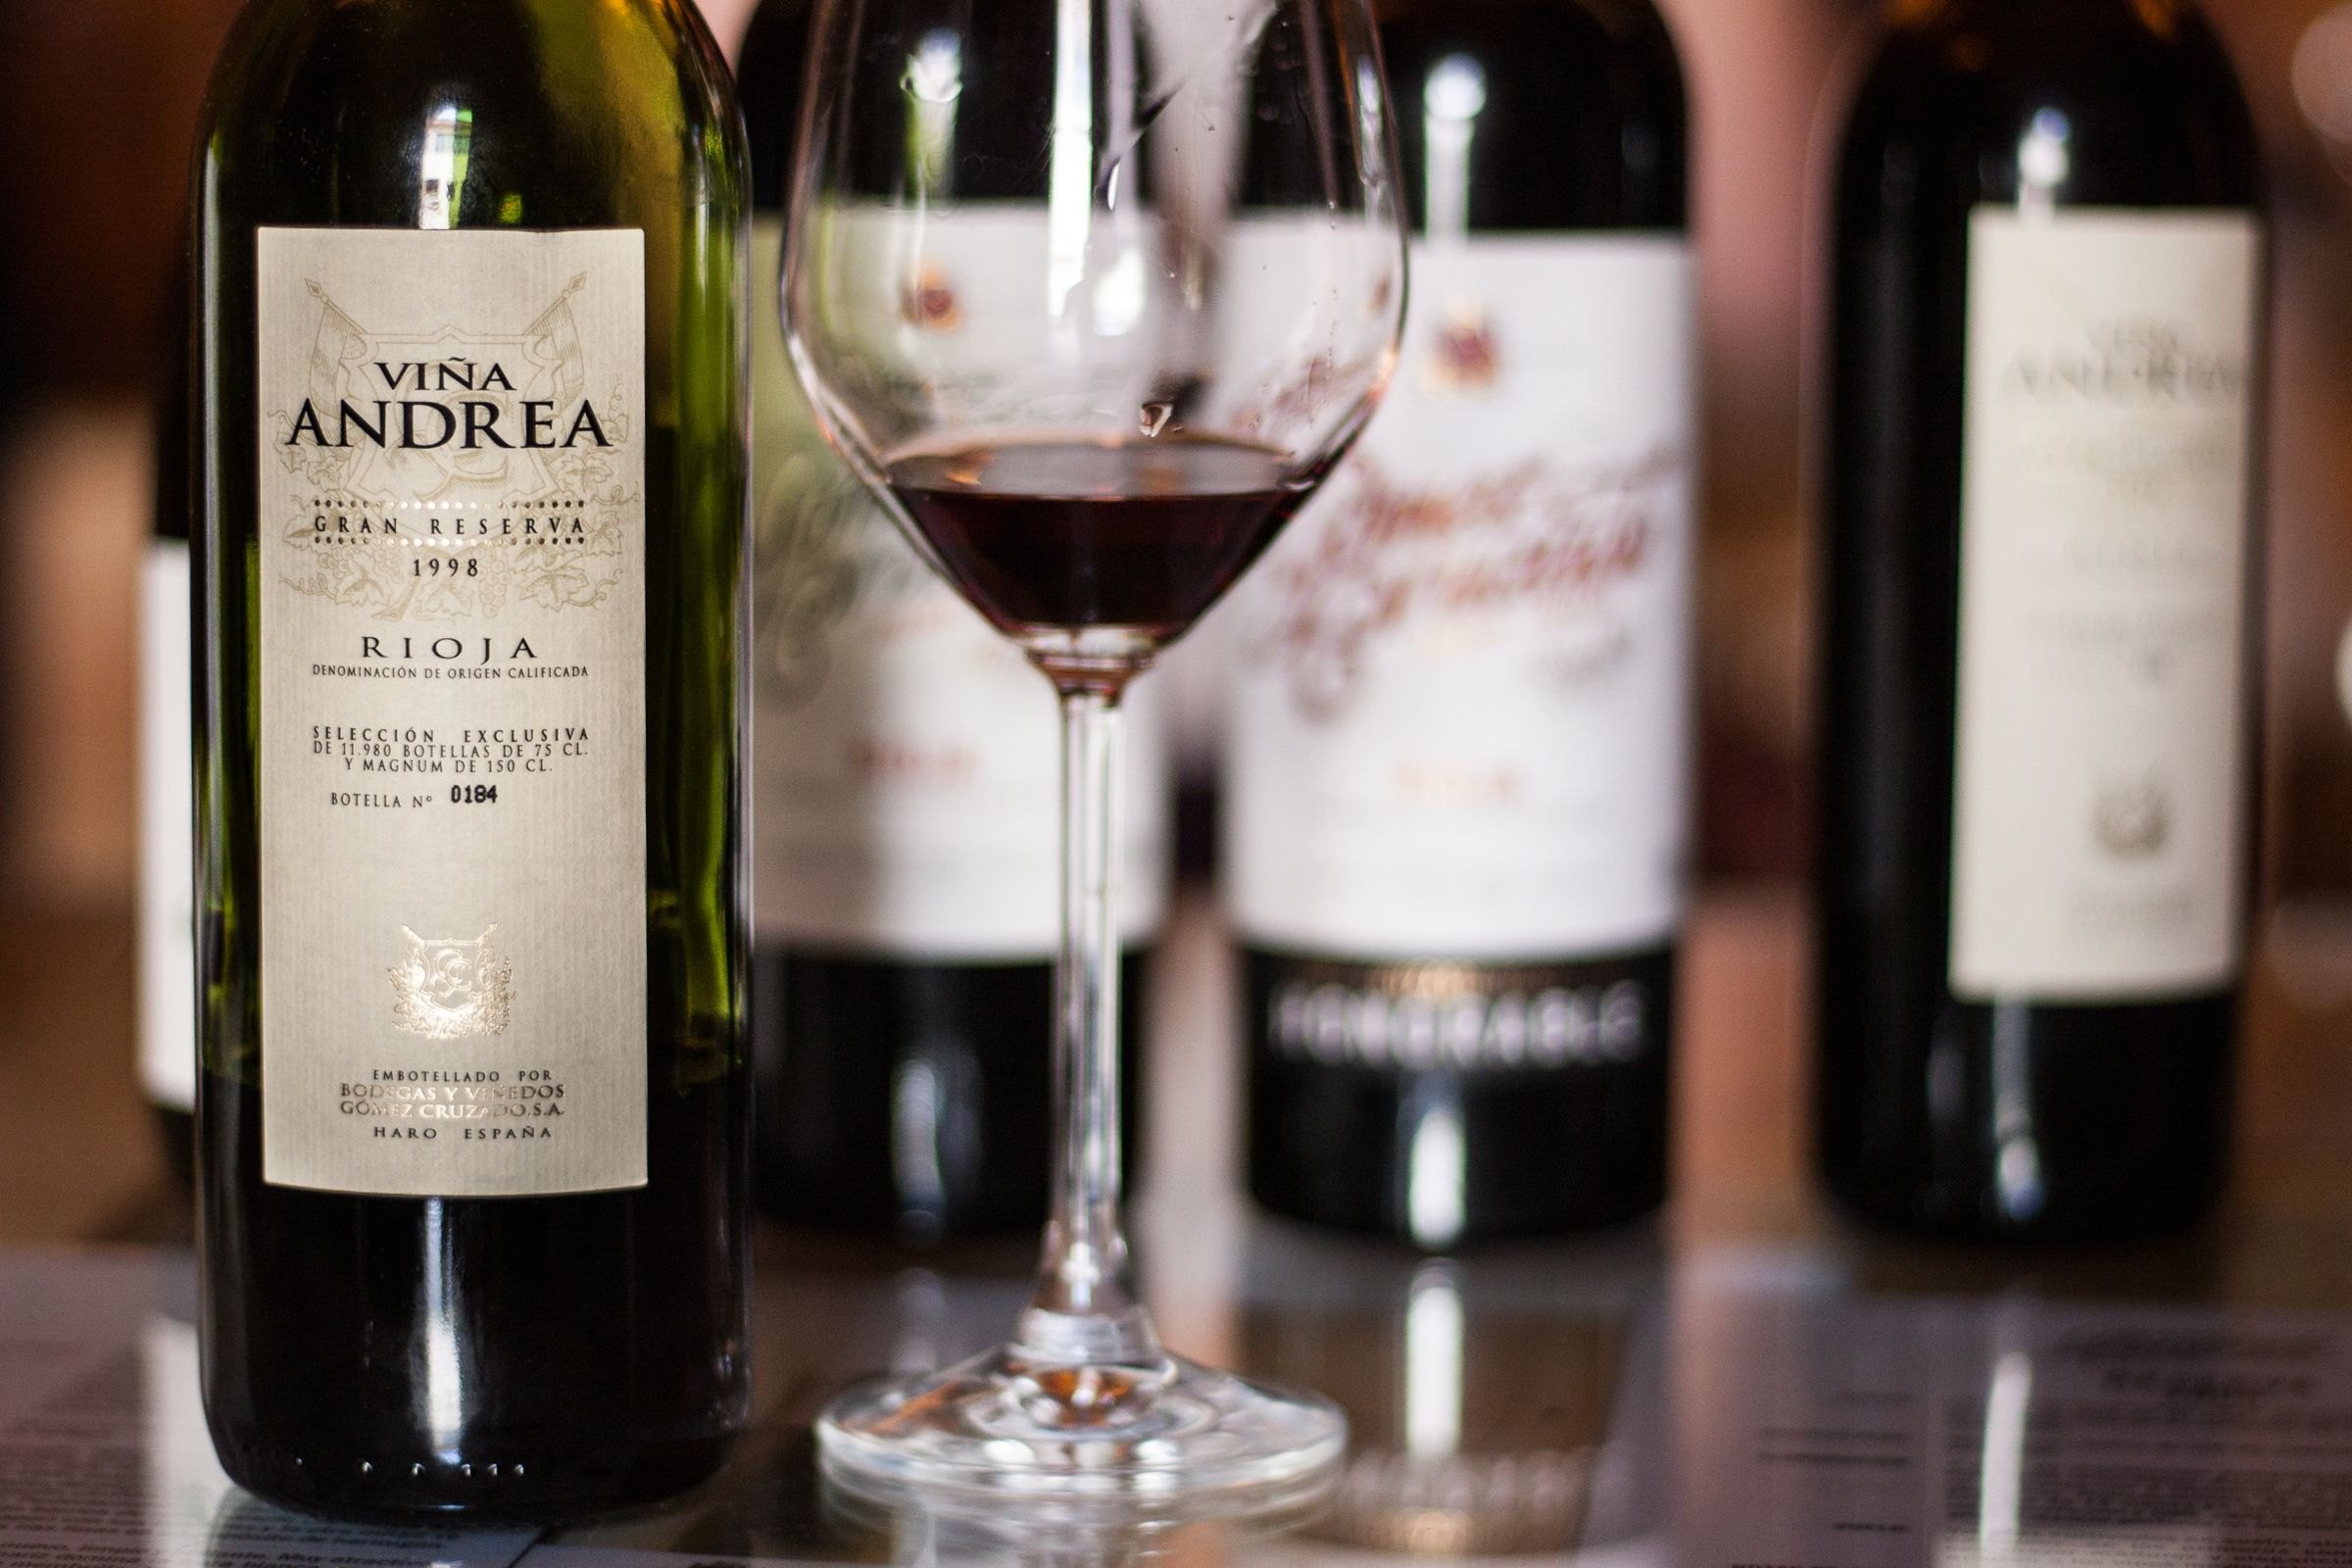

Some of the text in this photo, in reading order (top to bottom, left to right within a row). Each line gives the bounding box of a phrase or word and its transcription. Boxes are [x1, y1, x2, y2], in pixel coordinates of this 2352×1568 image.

[375, 357, 517, 391] VIÑA
[284, 397, 614, 450] ANDREA
[314, 514, 585, 536] GRAN RESERVA
[413, 558, 480, 578] 1998
[362, 635, 538, 665] RIOJA
[312, 662, 590, 680] DENOMINACIÓN DE ORIGEN CALIFICADA
[313, 725, 590, 744] SELECCIÓN EXCLUSIVA
[313, 740, 590, 759] DE 11.980 BOTELLAS DE 75 CL.
[345, 757, 555, 774] Y MAGNUM DE 150 CL.
[330, 791, 403, 809] BOTELLA
[450, 783, 499, 806] 0184
[372, 1068, 552, 1083] EMBOTELLADO POR
[340, 1082, 438, 1101] BODEGAS
[443, 1086, 459, 1102] Y
[373, 1125, 553, 1142] HARO ESPAÑA
